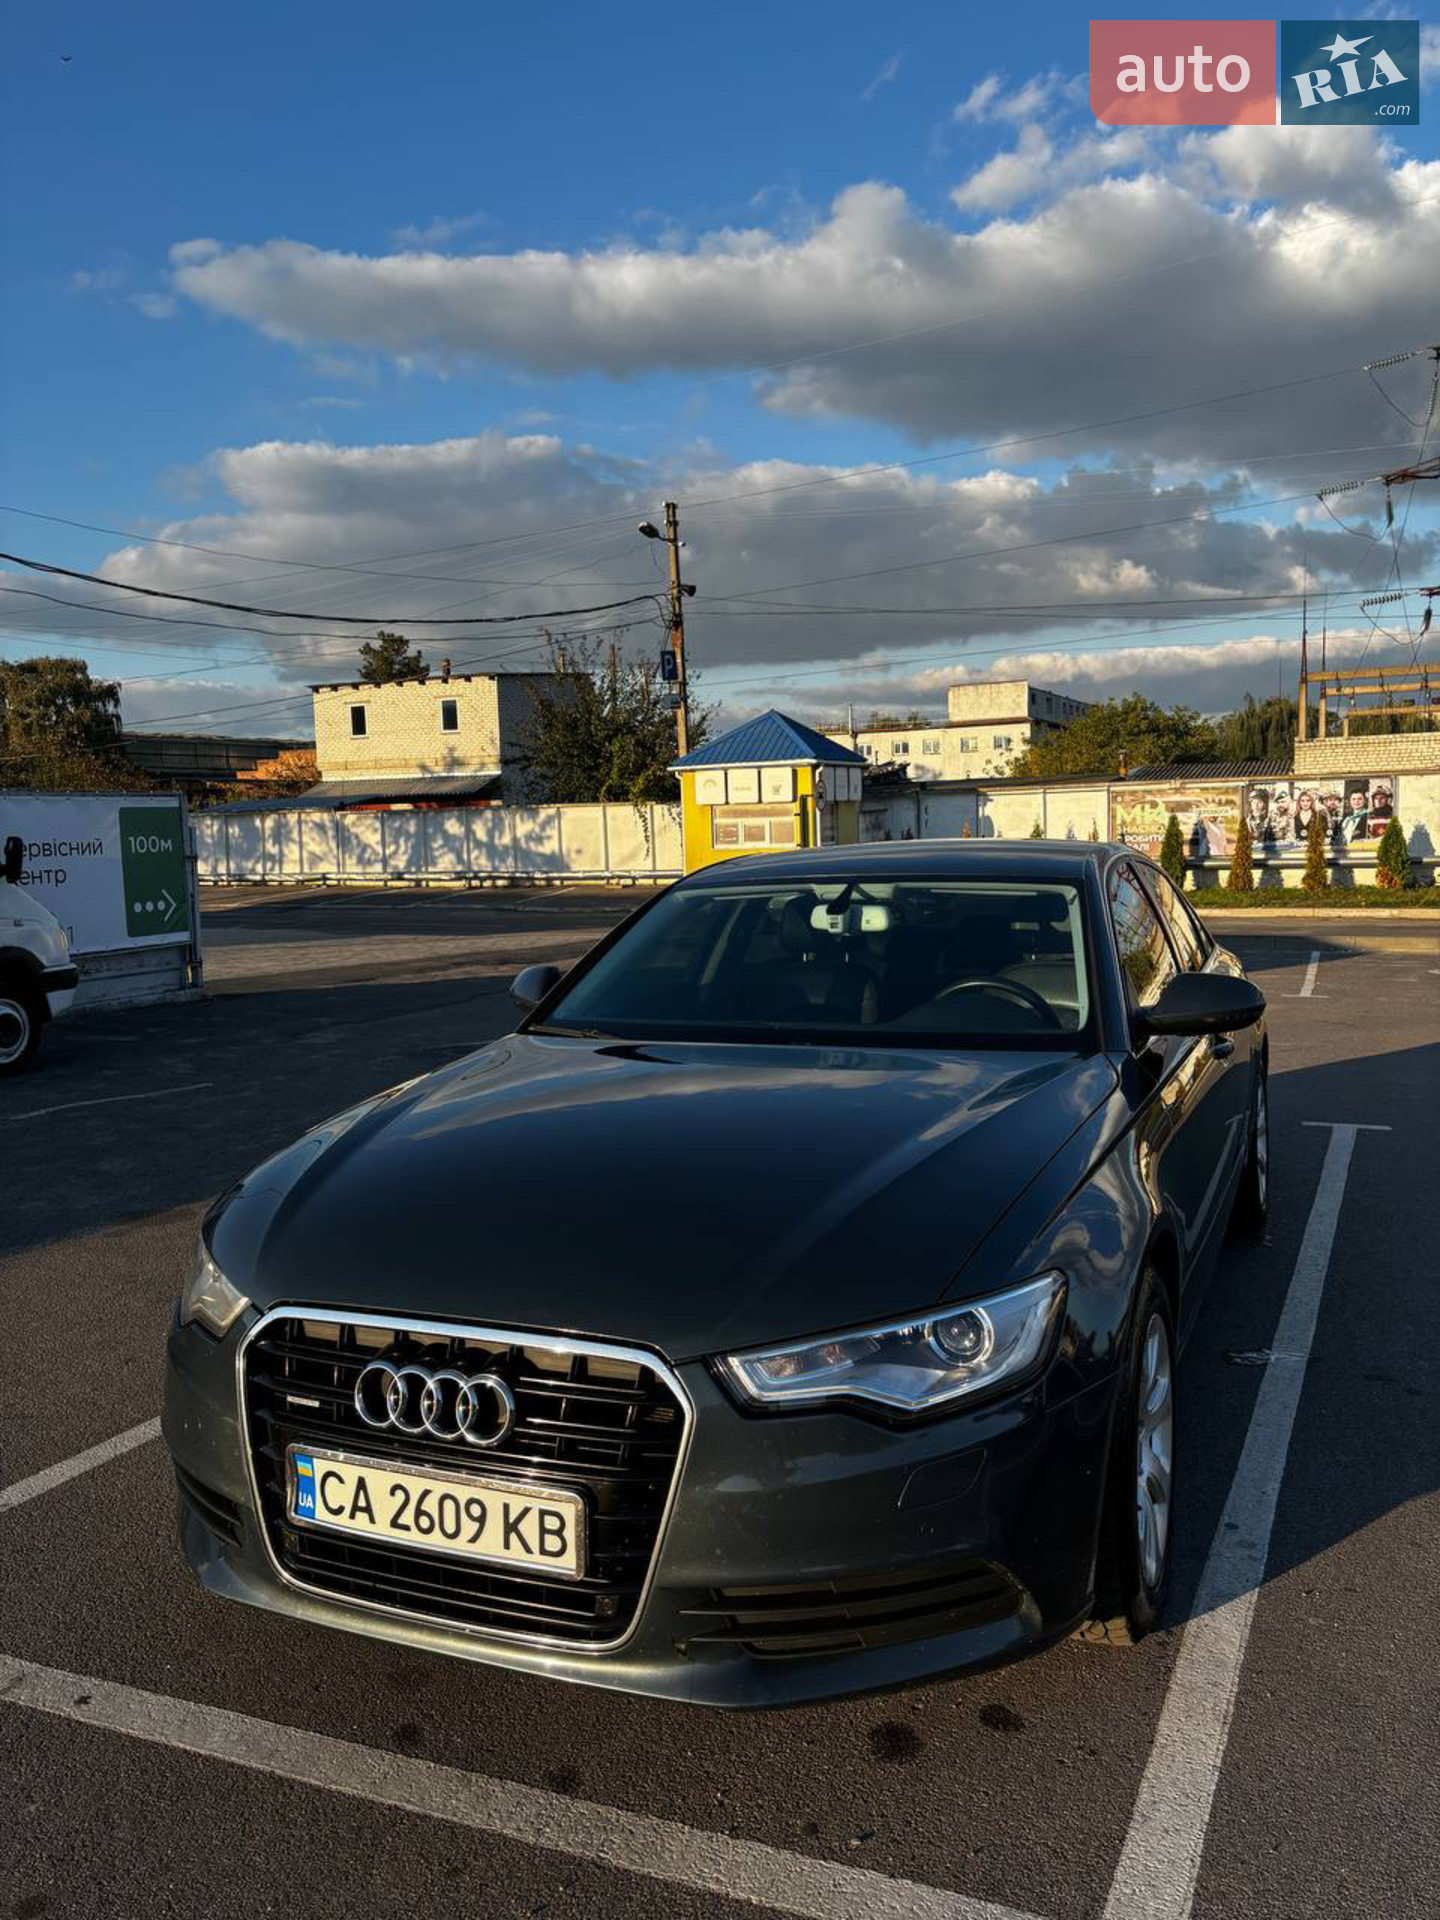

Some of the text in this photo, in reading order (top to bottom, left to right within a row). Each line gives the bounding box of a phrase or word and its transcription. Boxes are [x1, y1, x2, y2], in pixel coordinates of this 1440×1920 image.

[664, 655, 674, 679] P
[4, 838, 103, 861] рвісний
[128, 835, 173, 854] 100м
[15, 868, 67, 888] ентр
[298, 1491, 314, 1510] UA
[320, 1470, 568, 1558] CA 2609 KB
